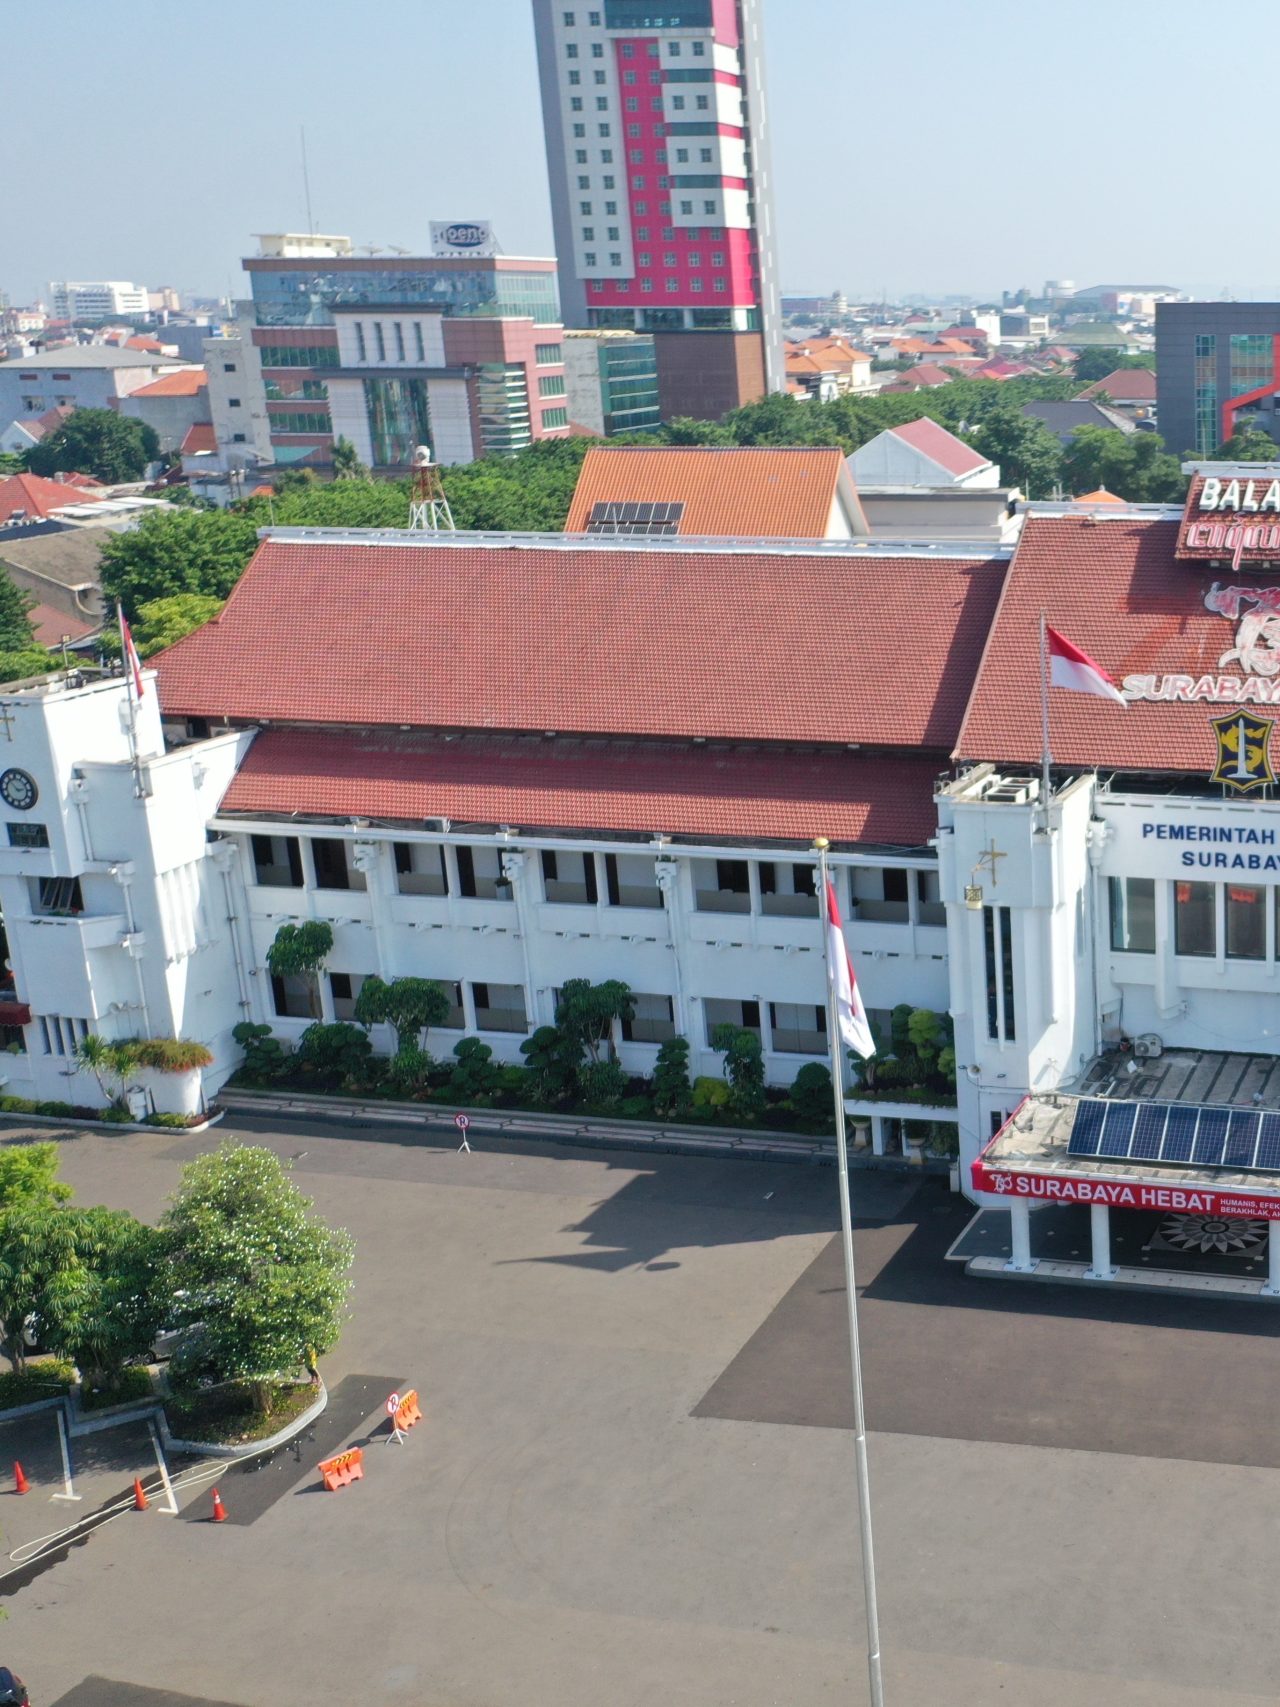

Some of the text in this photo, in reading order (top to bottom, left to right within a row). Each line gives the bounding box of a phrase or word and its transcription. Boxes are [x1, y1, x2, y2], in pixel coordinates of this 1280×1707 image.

[1142, 823, 1275, 845] PEMERINTAH
[1016, 1177, 1135, 1205] SURABAYA
[1141, 1189, 1215, 1211] HEBAT
[1220, 1199, 1258, 1209] HUMANIS,
[1220, 1206, 1270, 1217] BERAKHLAK,
